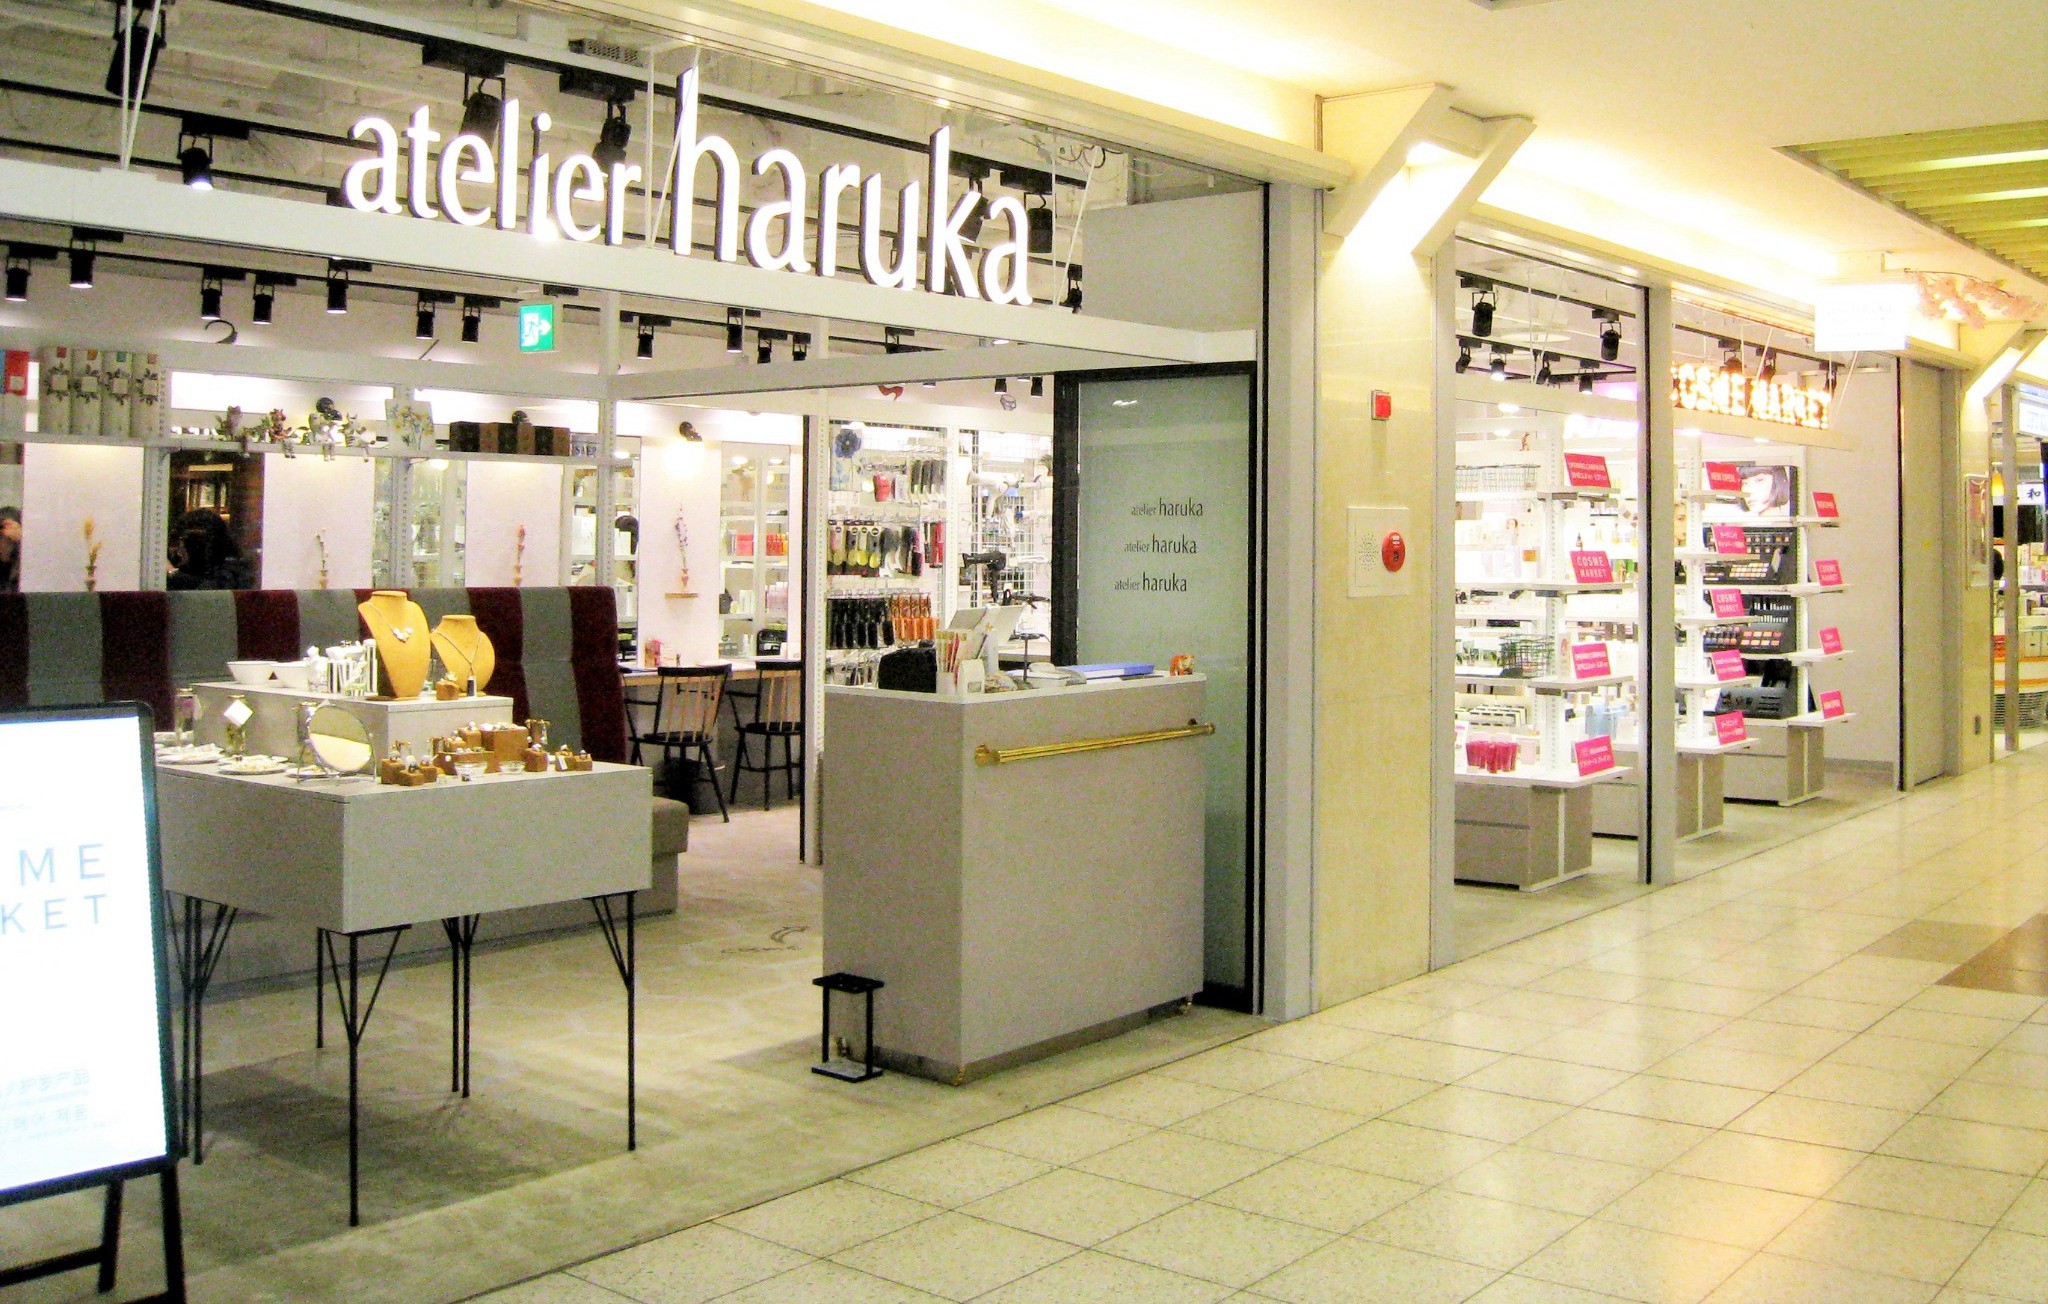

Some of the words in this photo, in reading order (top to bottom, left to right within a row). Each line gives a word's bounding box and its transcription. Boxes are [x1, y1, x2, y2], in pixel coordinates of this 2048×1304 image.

[343, 98, 642, 246] atelier
[673, 66, 1032, 306] haruka
[1131, 503, 1157, 516] atelier
[1159, 497, 1203, 517] haruka
[1124, 540, 1150, 553] atelier
[1152, 533, 1197, 554] haruka
[1576, 556, 1604, 567] COSME
[1580, 568, 1607, 578] MARKET
[1114, 578, 1140, 591] atelier
[1142, 571, 1187, 592] haruka
[1716, 593, 1737, 604] COSME
[1718, 604, 1740, 613] MARKET
